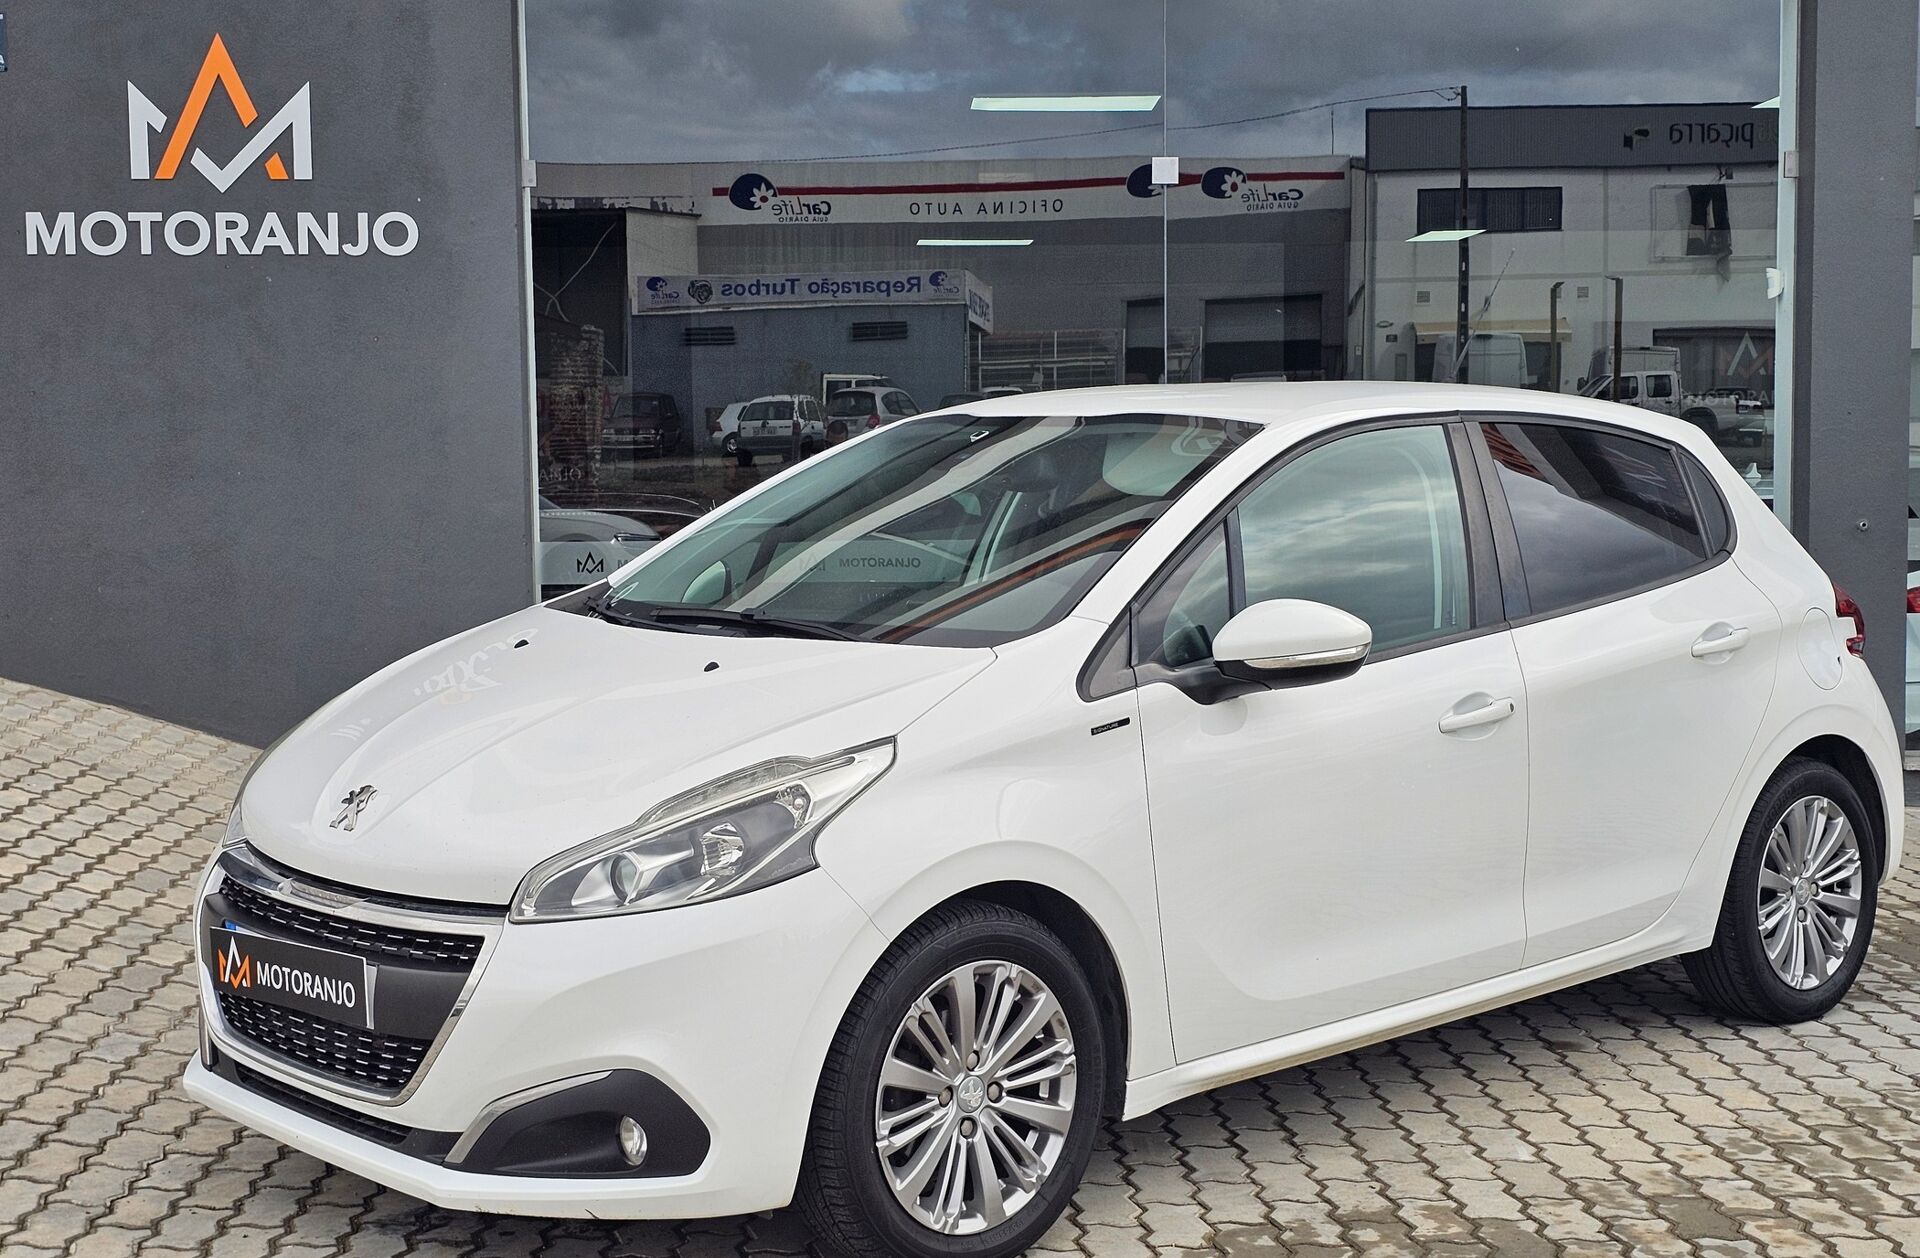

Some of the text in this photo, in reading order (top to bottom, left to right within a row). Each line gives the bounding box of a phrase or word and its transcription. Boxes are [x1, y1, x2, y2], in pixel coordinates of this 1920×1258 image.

[24, 210, 420, 257] MOTORANJO
[839, 557, 921, 569] MOTORANJO
[256, 960, 356, 1008] MOTORANJO
